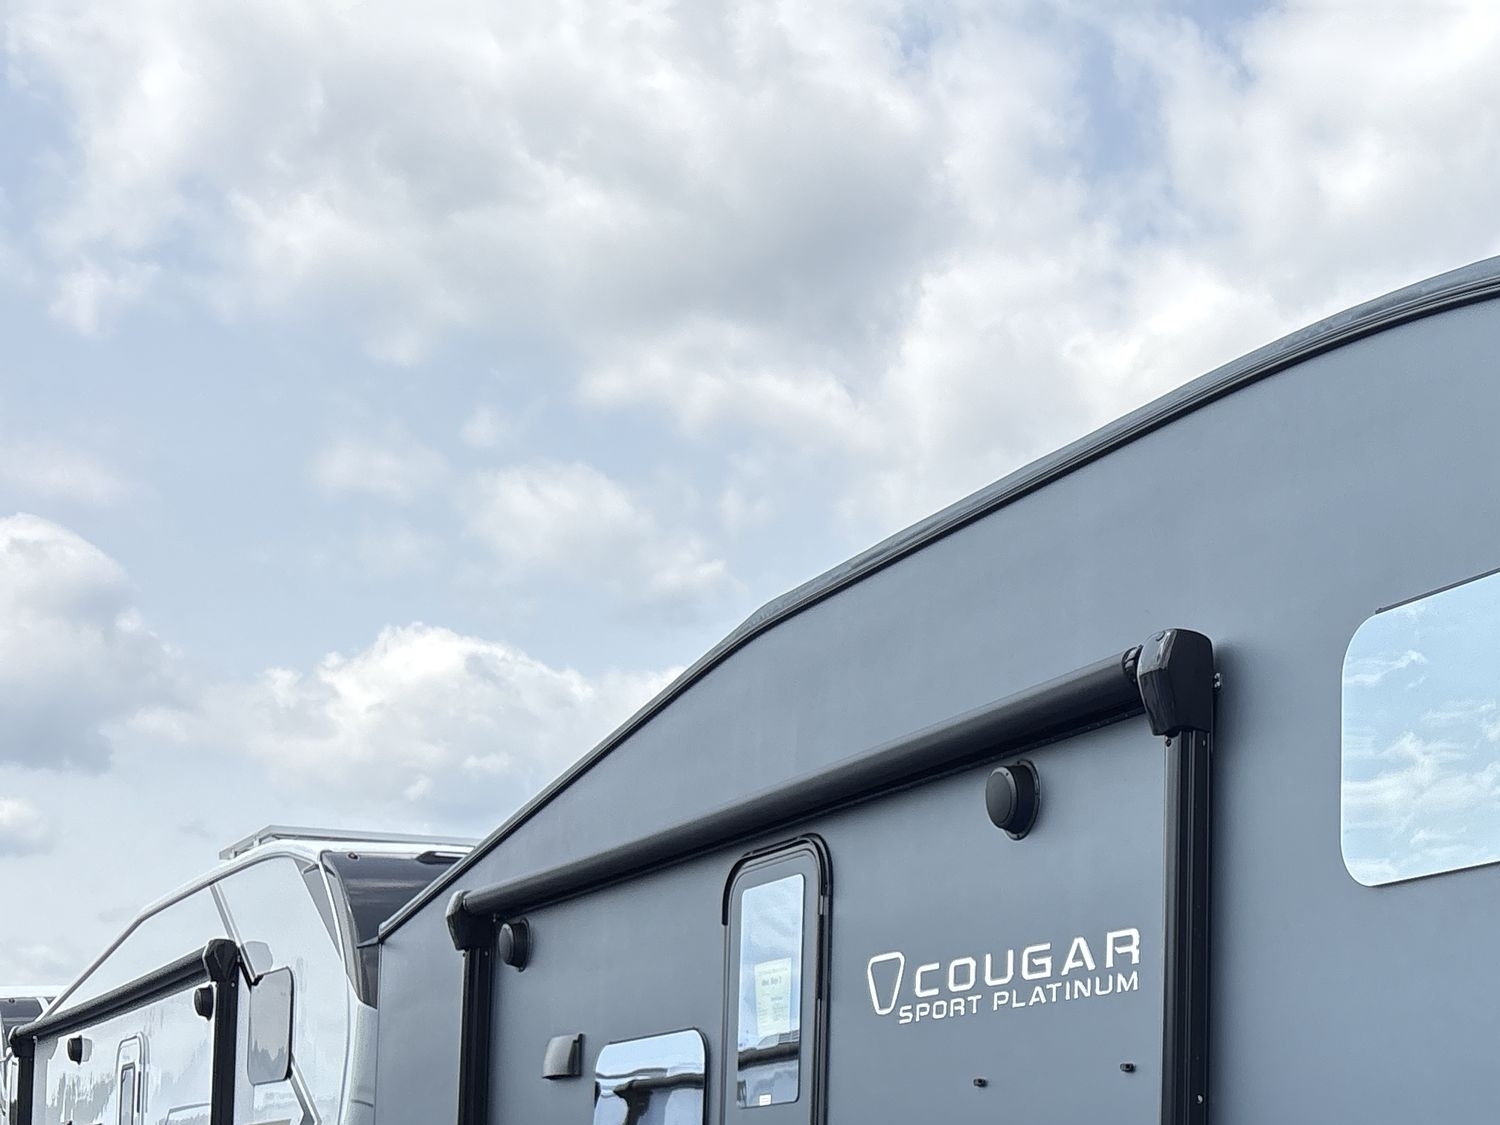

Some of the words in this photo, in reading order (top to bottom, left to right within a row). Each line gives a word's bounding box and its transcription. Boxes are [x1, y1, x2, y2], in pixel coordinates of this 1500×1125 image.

[915, 927, 1141, 998] COUGAR
[899, 995, 982, 1024] SPORT
[993, 971, 1139, 1011] PLATINUM
